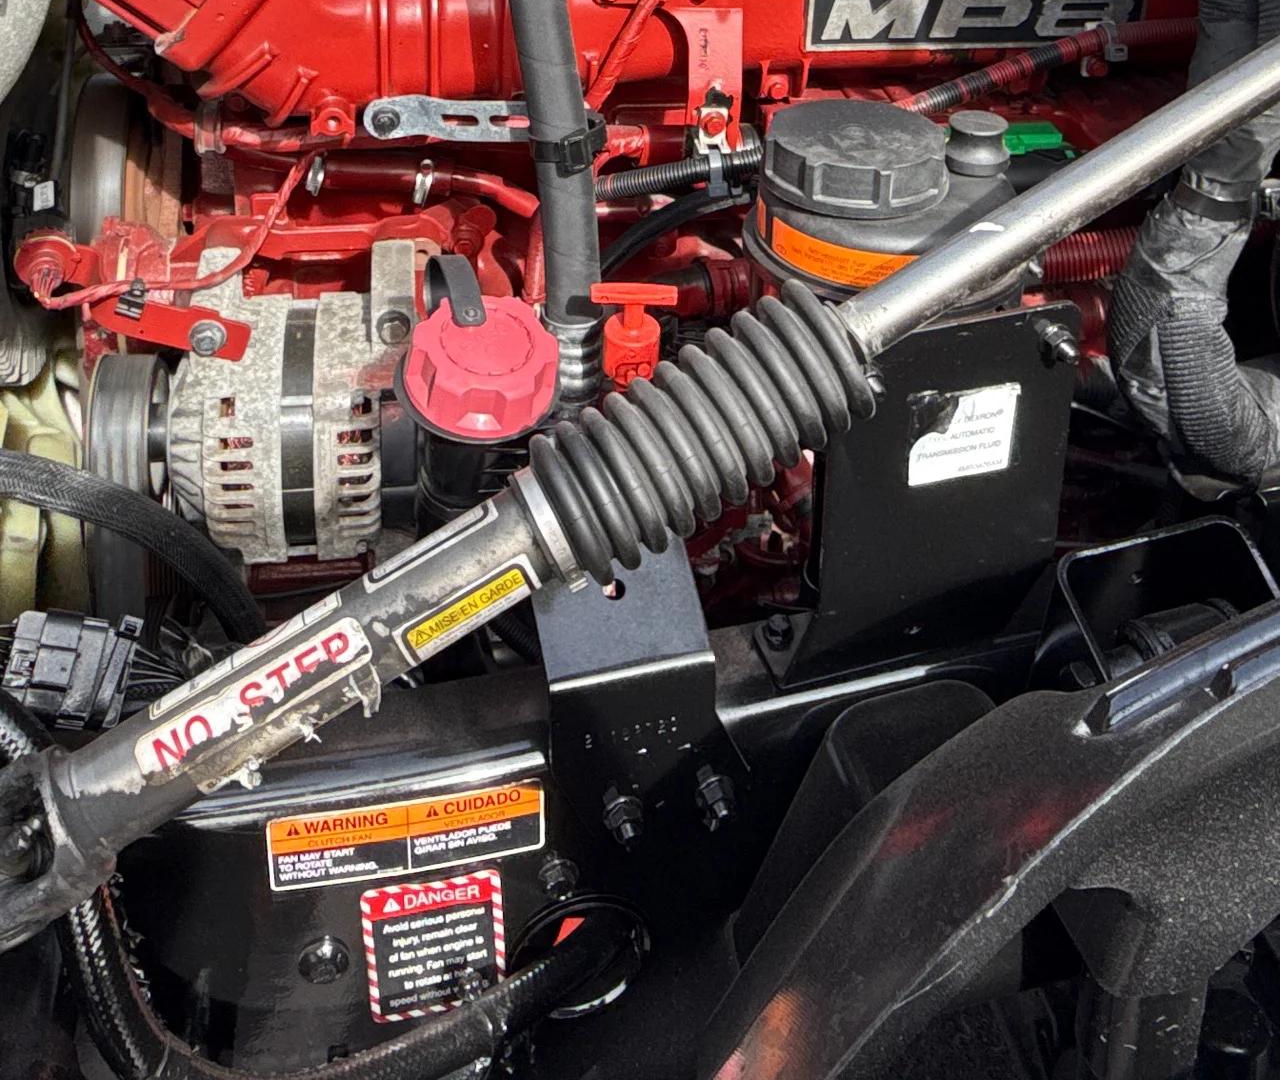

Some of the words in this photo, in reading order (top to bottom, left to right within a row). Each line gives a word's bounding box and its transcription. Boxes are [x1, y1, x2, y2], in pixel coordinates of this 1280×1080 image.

[950, 426, 995, 440] AUTOMATIC
[979, 439, 1002, 450] FLUID
[428, 611, 460, 633] MISE
[460, 599, 479, 617] EN
[479, 572, 522, 605] GARDE
[151, 714, 213, 771] NO
[239, 631, 350, 715] STEP
[443, 789, 521, 815] CUIDADO
[304, 812, 388, 835] WARNING
[443, 811, 506, 828] VENTILADOR
[307, 835, 349, 847] CLUTCH
[351, 832, 372, 841] FAN
[413, 828, 477, 846] VENTILADOR
[478, 821, 512, 834] PUEDE
[414, 843, 447, 855] GIRAR
[448, 840, 465, 850] SIN
[466, 833, 498, 846] AVISO.
[278, 854, 298, 865] FAN
[300, 851, 321, 862] MAY
[323, 847, 355, 859] START
[279, 864, 293, 872] TO
[295, 859, 333, 871] ROTATE
[279, 867, 326, 881] WITHOUT
[328, 861, 379, 876] WARNING.
[403, 885, 480, 910] DANGER
[383, 922, 409, 934] Avoid
[410, 915, 444, 929] serious
[445, 907, 485, 923] personal
[422, 927, 454, 941] remain
[455, 922, 478, 934] clear
[389, 951, 398, 963] of
[400, 950, 415, 961] fan
[417, 945, 442, 958] when
[443, 938, 474, 952] engine
[475, 935, 485, 945] is
[388, 965, 425, 978] running.
[426, 959, 444, 970] Fan
[446, 956, 465, 966] may
[466, 949, 488, 962] start
[404, 980, 414, 990] to
[415, 974, 442, 988] rotate
[389, 994, 418, 1008] speed
[419, 987, 451, 1001] without
